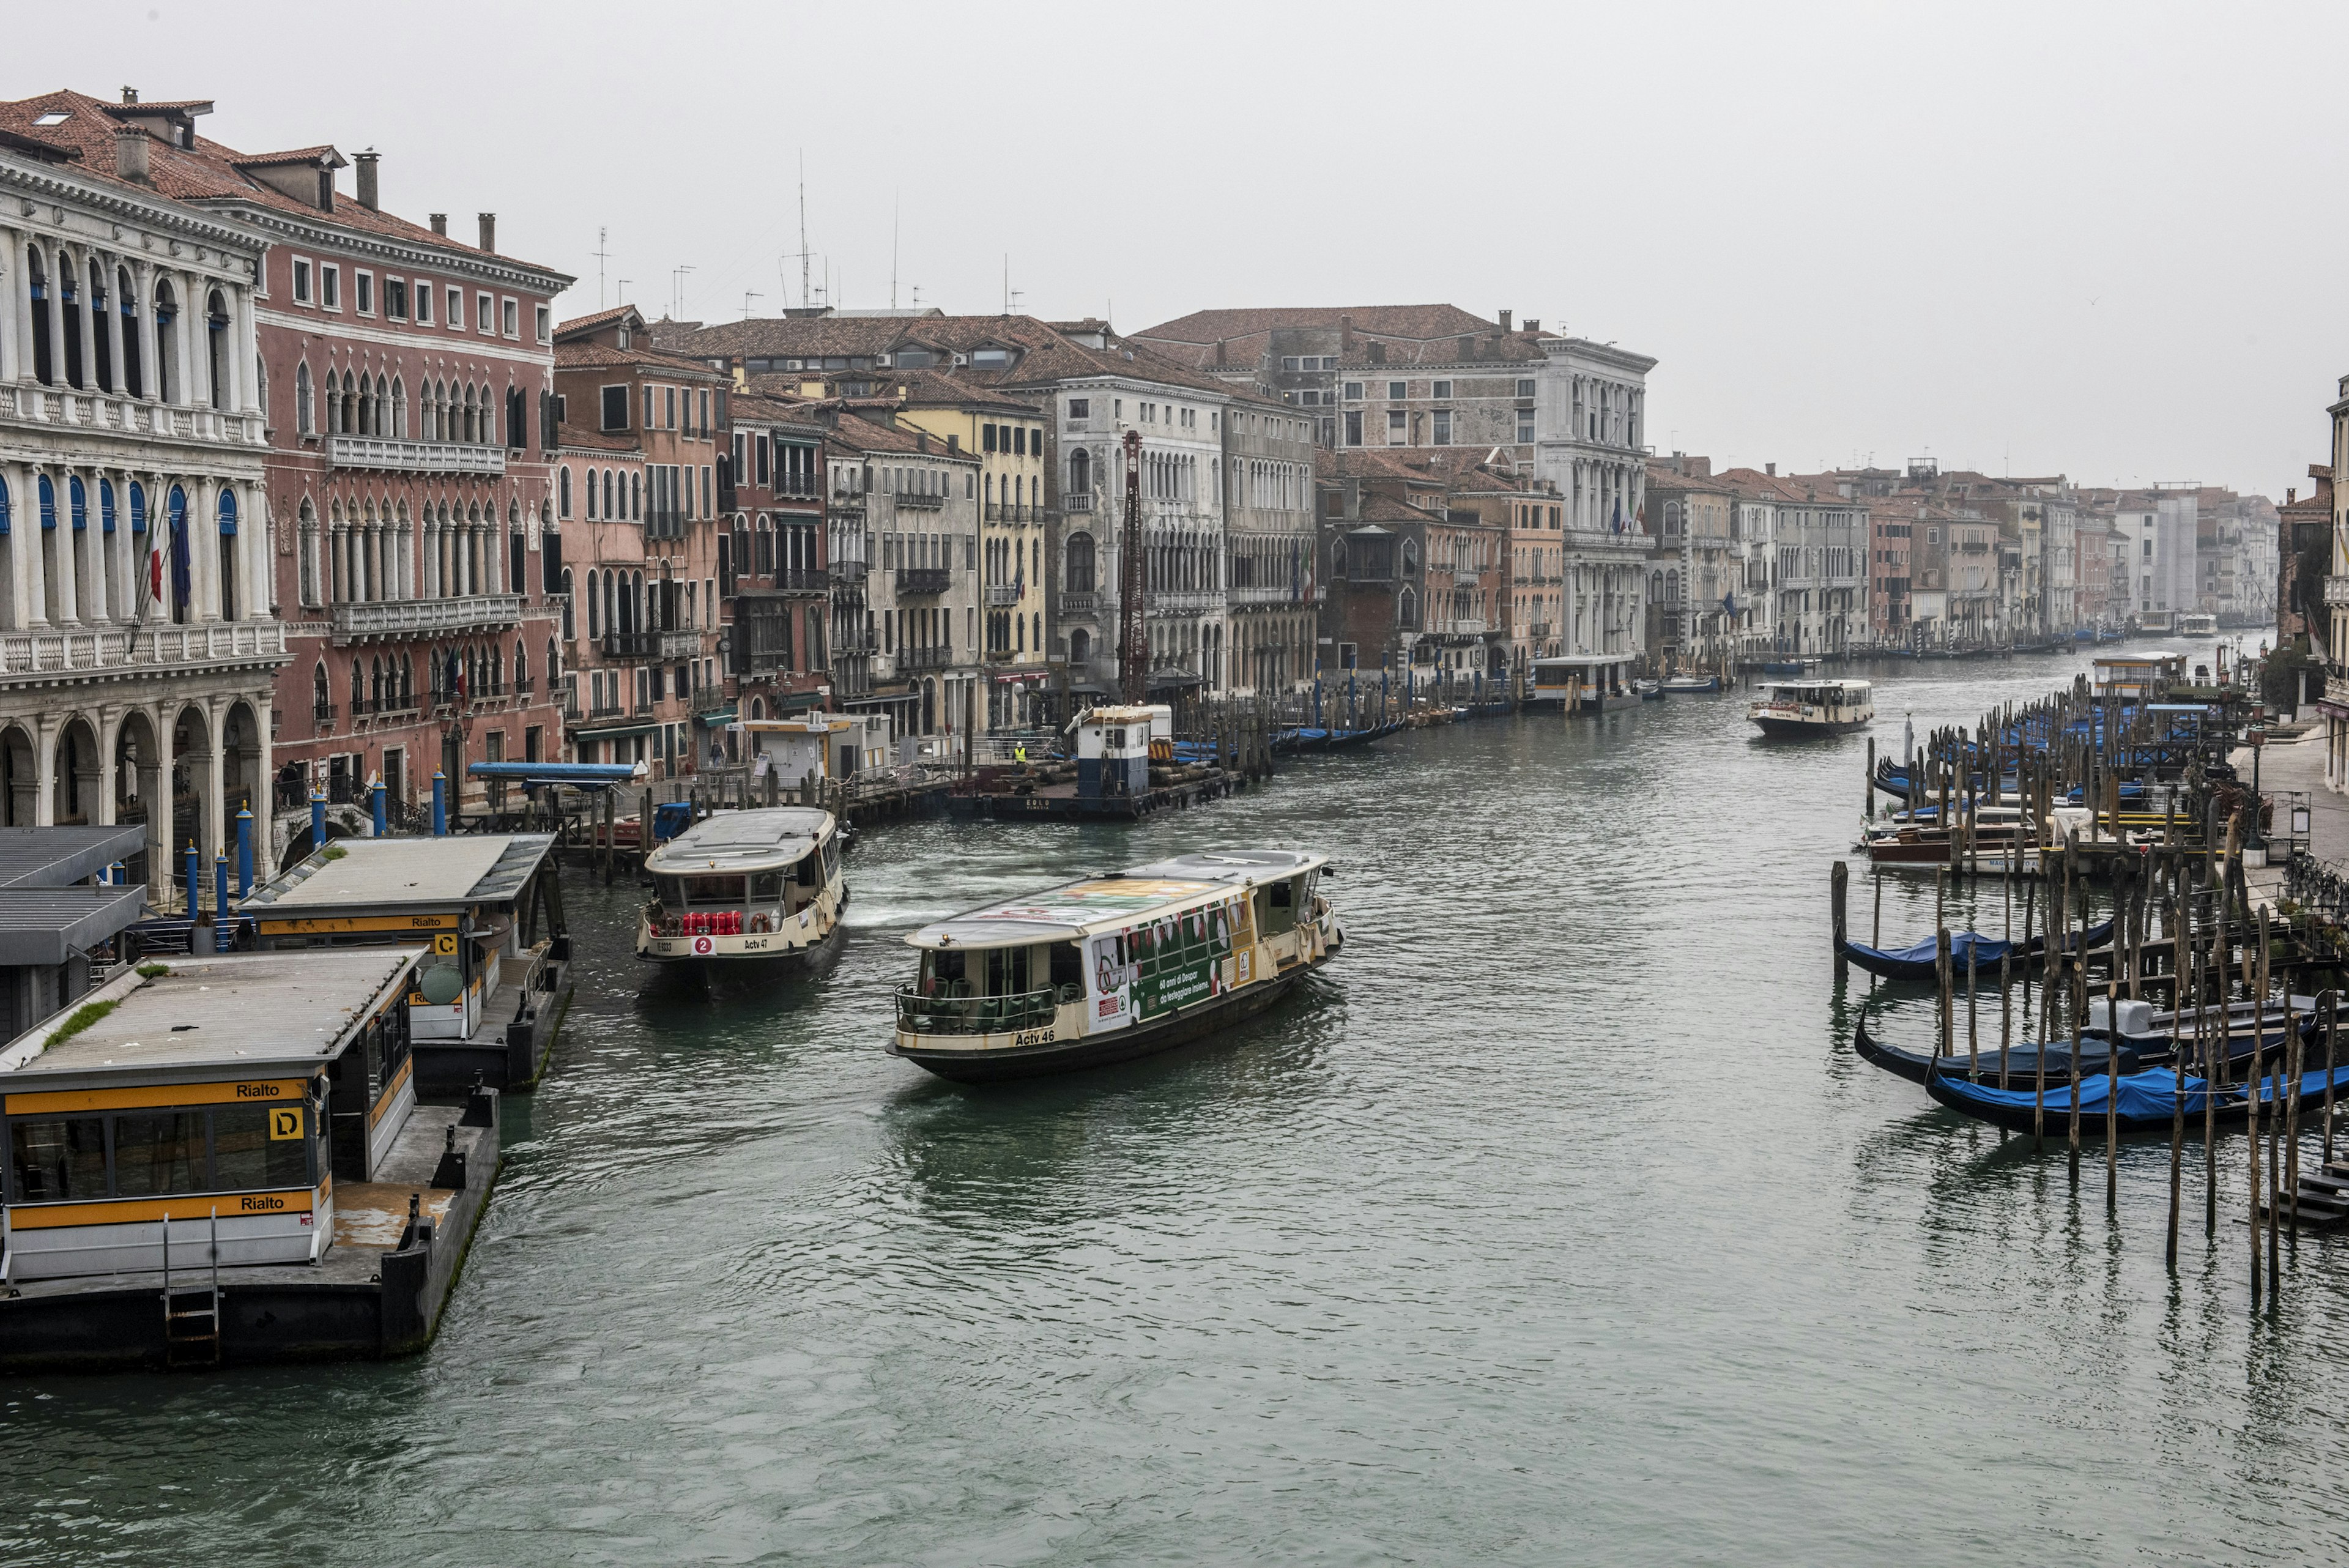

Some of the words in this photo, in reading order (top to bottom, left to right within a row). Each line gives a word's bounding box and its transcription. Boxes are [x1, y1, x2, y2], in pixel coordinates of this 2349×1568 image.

[412, 918, 440, 927] Rialto
[439, 937, 453, 953] C
[699, 940, 707, 951] 2
[744, 940, 760, 949] Actv
[760, 939, 768, 948] 47
[1159, 979, 1166, 990] 60
[1166, 975, 1177, 988] anni
[1177, 974, 1182, 984] di
[1182, 971, 1198, 983] Despar
[1160, 994, 1167, 1004] da
[1167, 987, 1192, 1001] festeggiare
[1192, 981, 1209, 993] insieme.
[1016, 1033, 1039, 1046] Actv
[1042, 1030, 1054, 1042] 46
[237, 1084, 280, 1097] Rialto
[276, 1113, 297, 1135] D
[242, 1197, 284, 1210] Rialto
